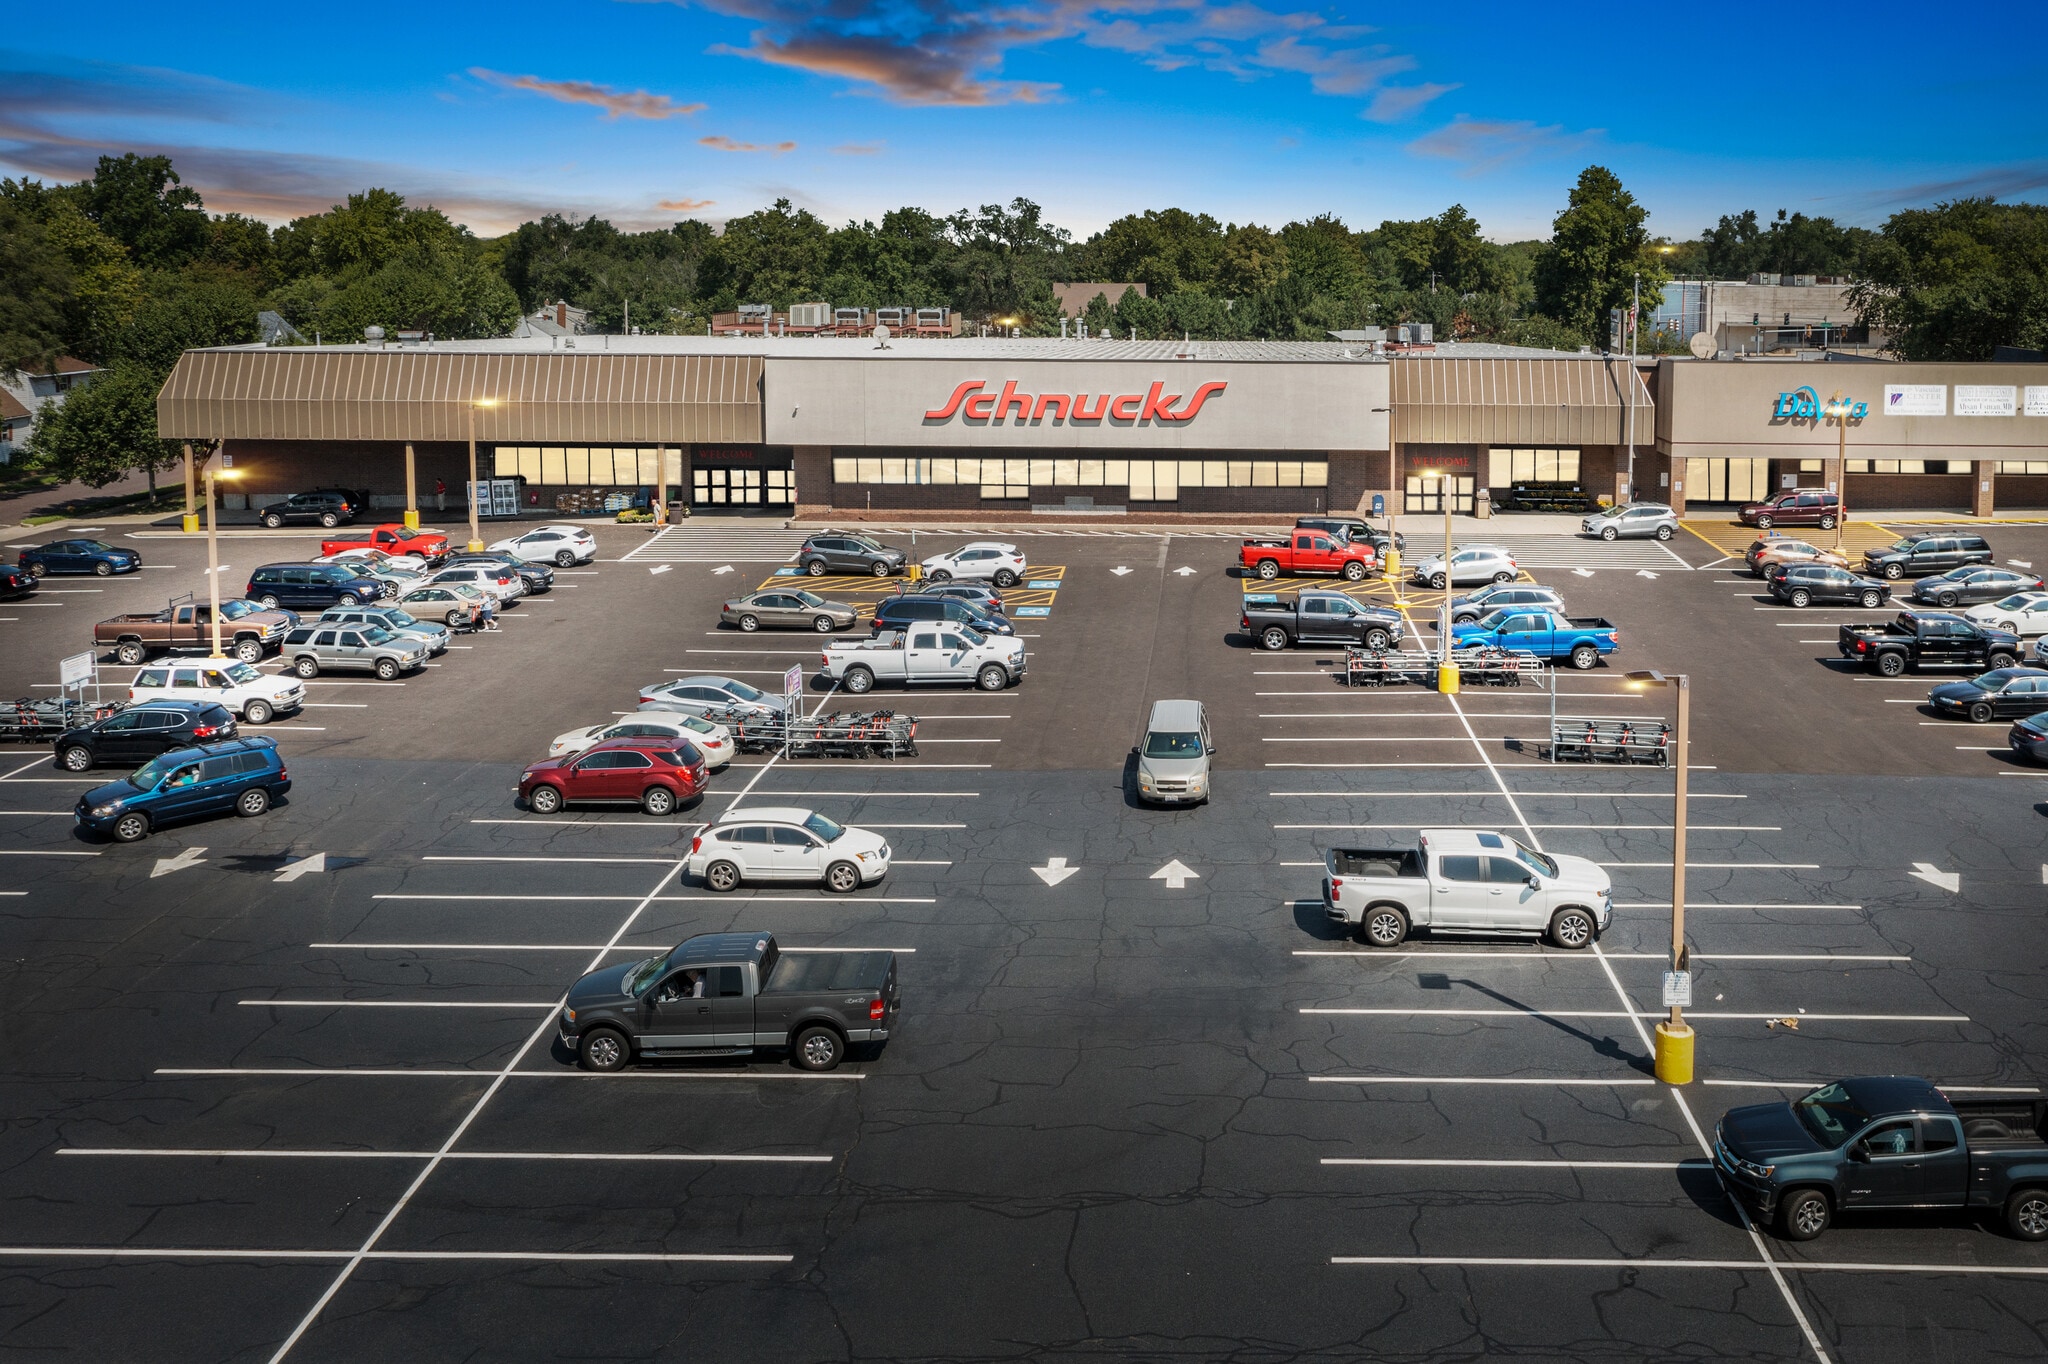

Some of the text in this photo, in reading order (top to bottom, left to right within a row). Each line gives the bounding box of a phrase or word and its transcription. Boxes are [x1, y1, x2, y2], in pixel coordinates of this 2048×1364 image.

[1774, 385, 1869, 422] DaVita
[699, 449, 754, 459] WELCOME
[1411, 456, 1470, 467] WELCOME
